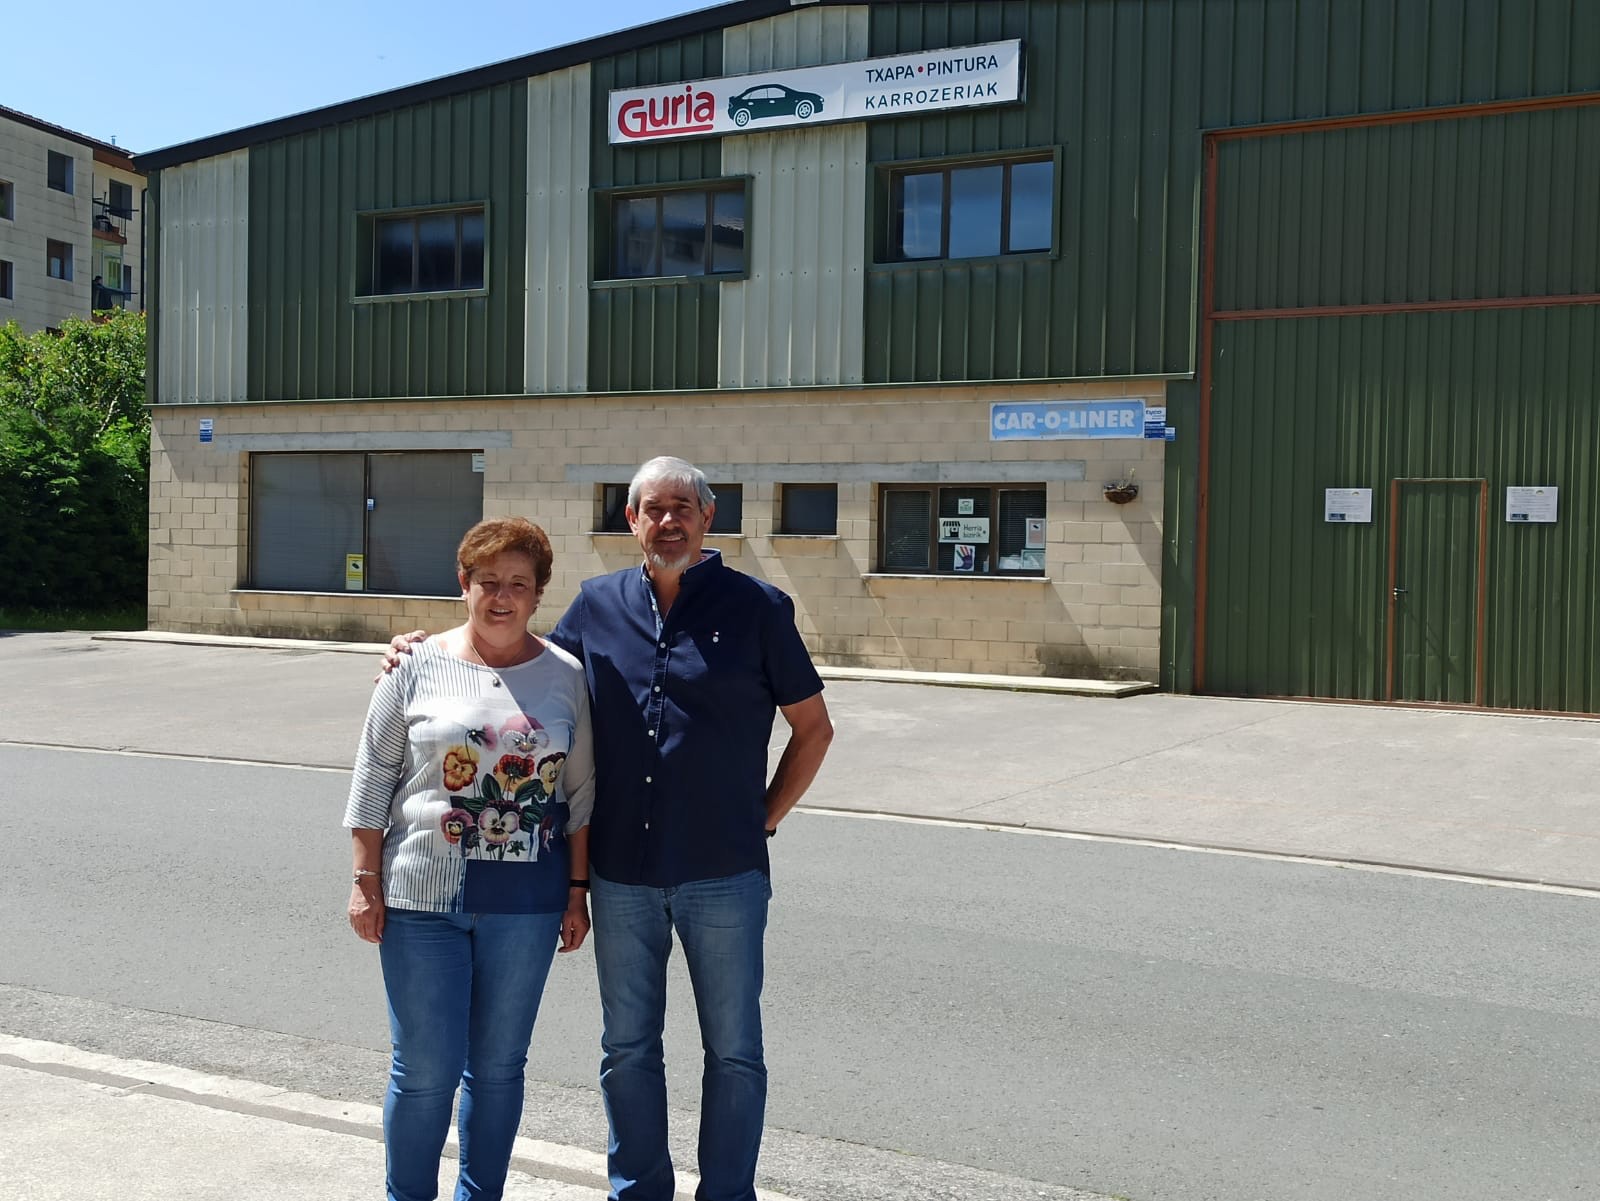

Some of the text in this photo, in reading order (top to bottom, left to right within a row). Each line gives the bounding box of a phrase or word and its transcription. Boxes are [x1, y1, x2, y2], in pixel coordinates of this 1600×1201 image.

[865, 55, 998, 83] TXAPA PINTURA
[865, 82, 998, 109] KARROZERIAK
[617, 85, 715, 138] Guria
[994, 409, 1135, 430] CAR-O-LINER
